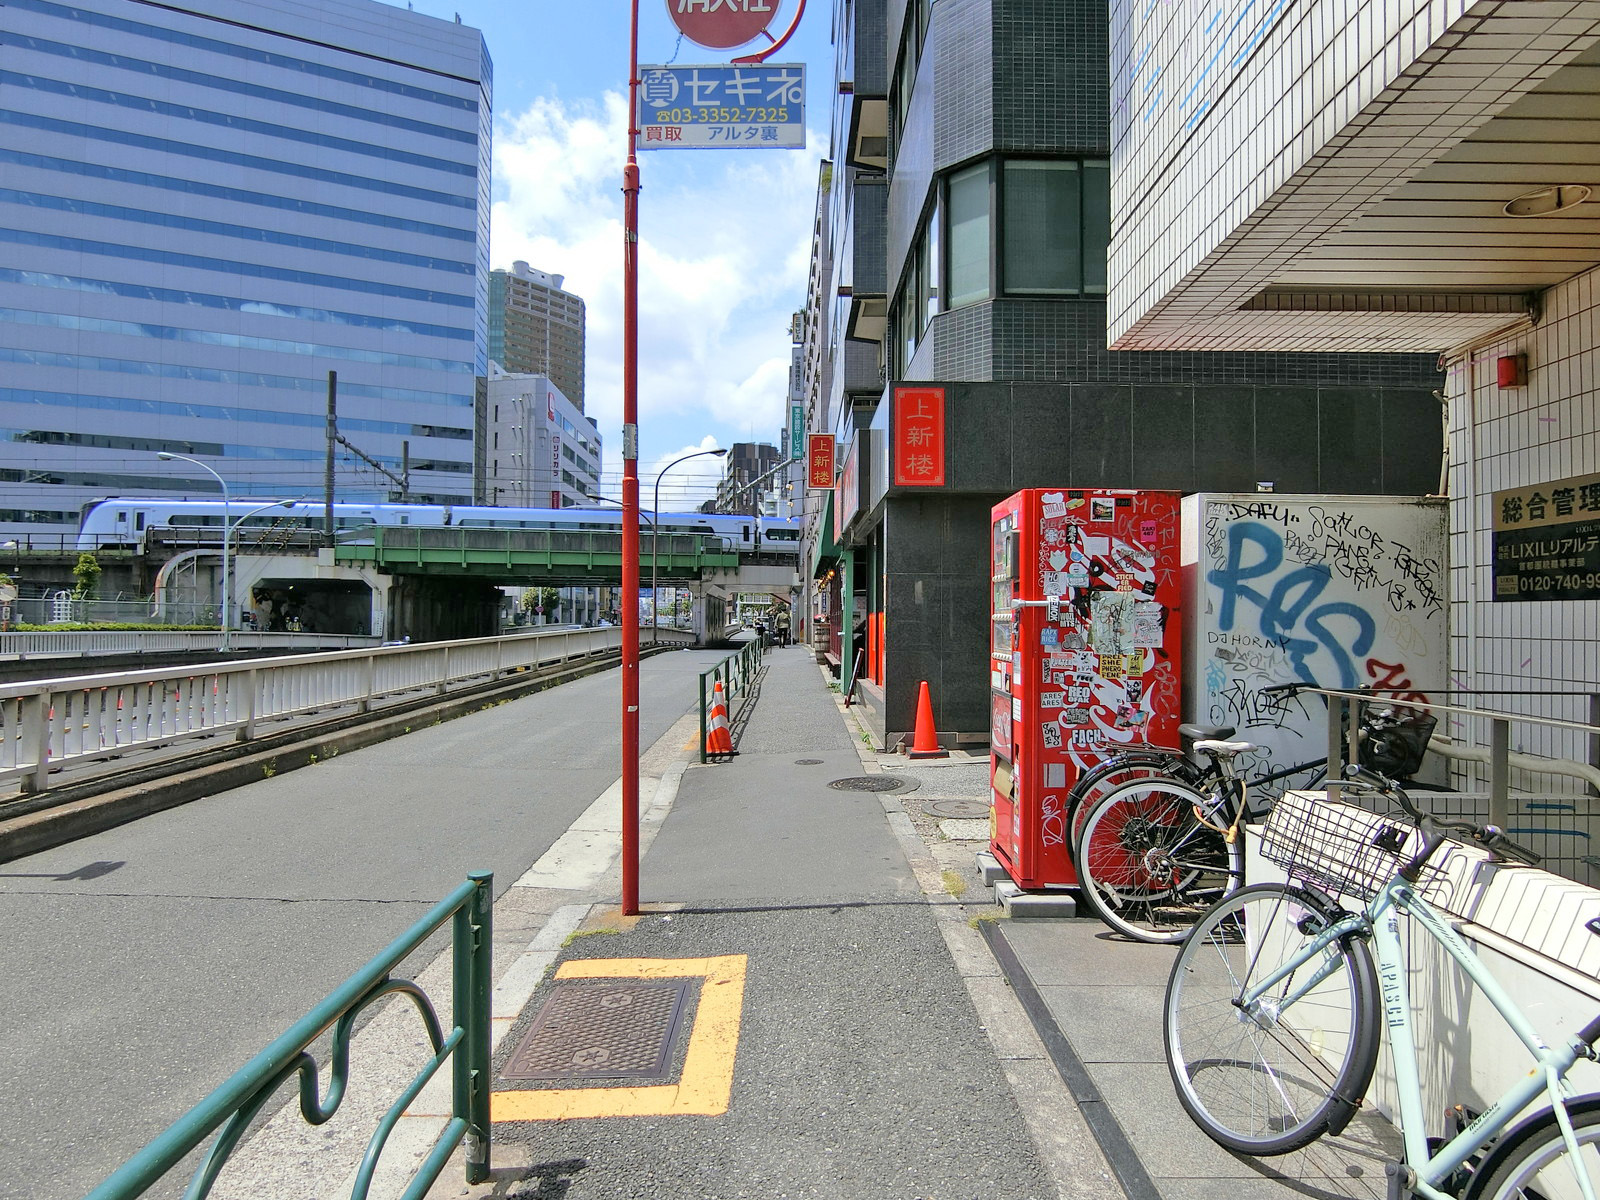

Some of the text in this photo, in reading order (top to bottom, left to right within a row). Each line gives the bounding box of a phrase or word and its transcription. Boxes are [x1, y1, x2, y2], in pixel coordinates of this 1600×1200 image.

[671, 108, 789, 122] 03-3352-7325
[646, 126, 778, 141] 買取 アルタ裏
[905, 398, 934, 476] 上新楼
[814, 440, 830, 483] 上新楼
[1502, 482, 1600, 524] 総合管理
[1511, 536, 1599, 559] LIXILリアルテ
